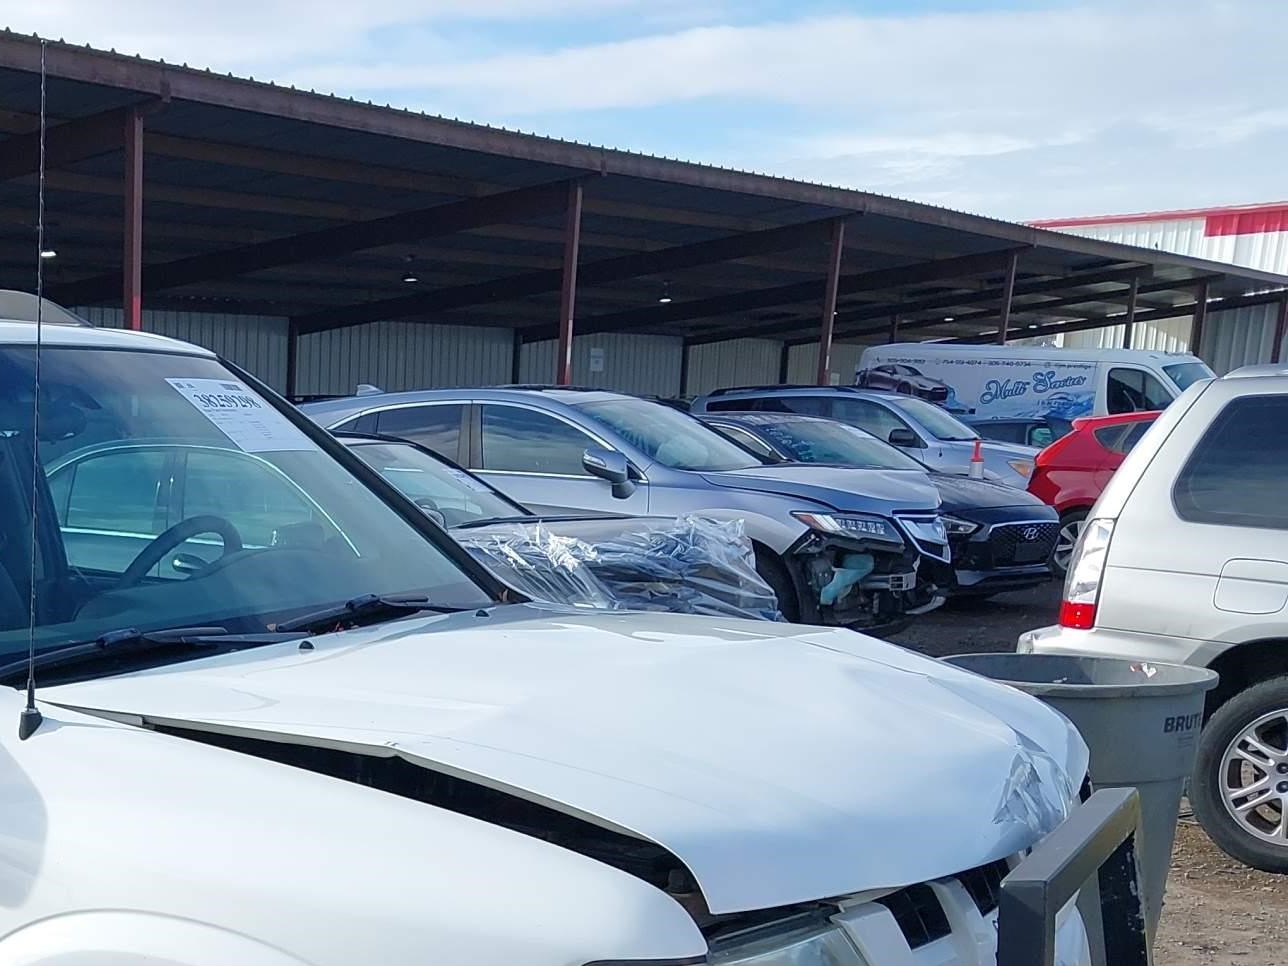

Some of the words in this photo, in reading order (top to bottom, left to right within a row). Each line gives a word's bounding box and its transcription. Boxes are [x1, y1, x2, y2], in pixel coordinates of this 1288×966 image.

[979, 378, 1032, 404] Multi
[1032, 370, 1087, 394] Services
[193, 394, 262, 409] 38259298
